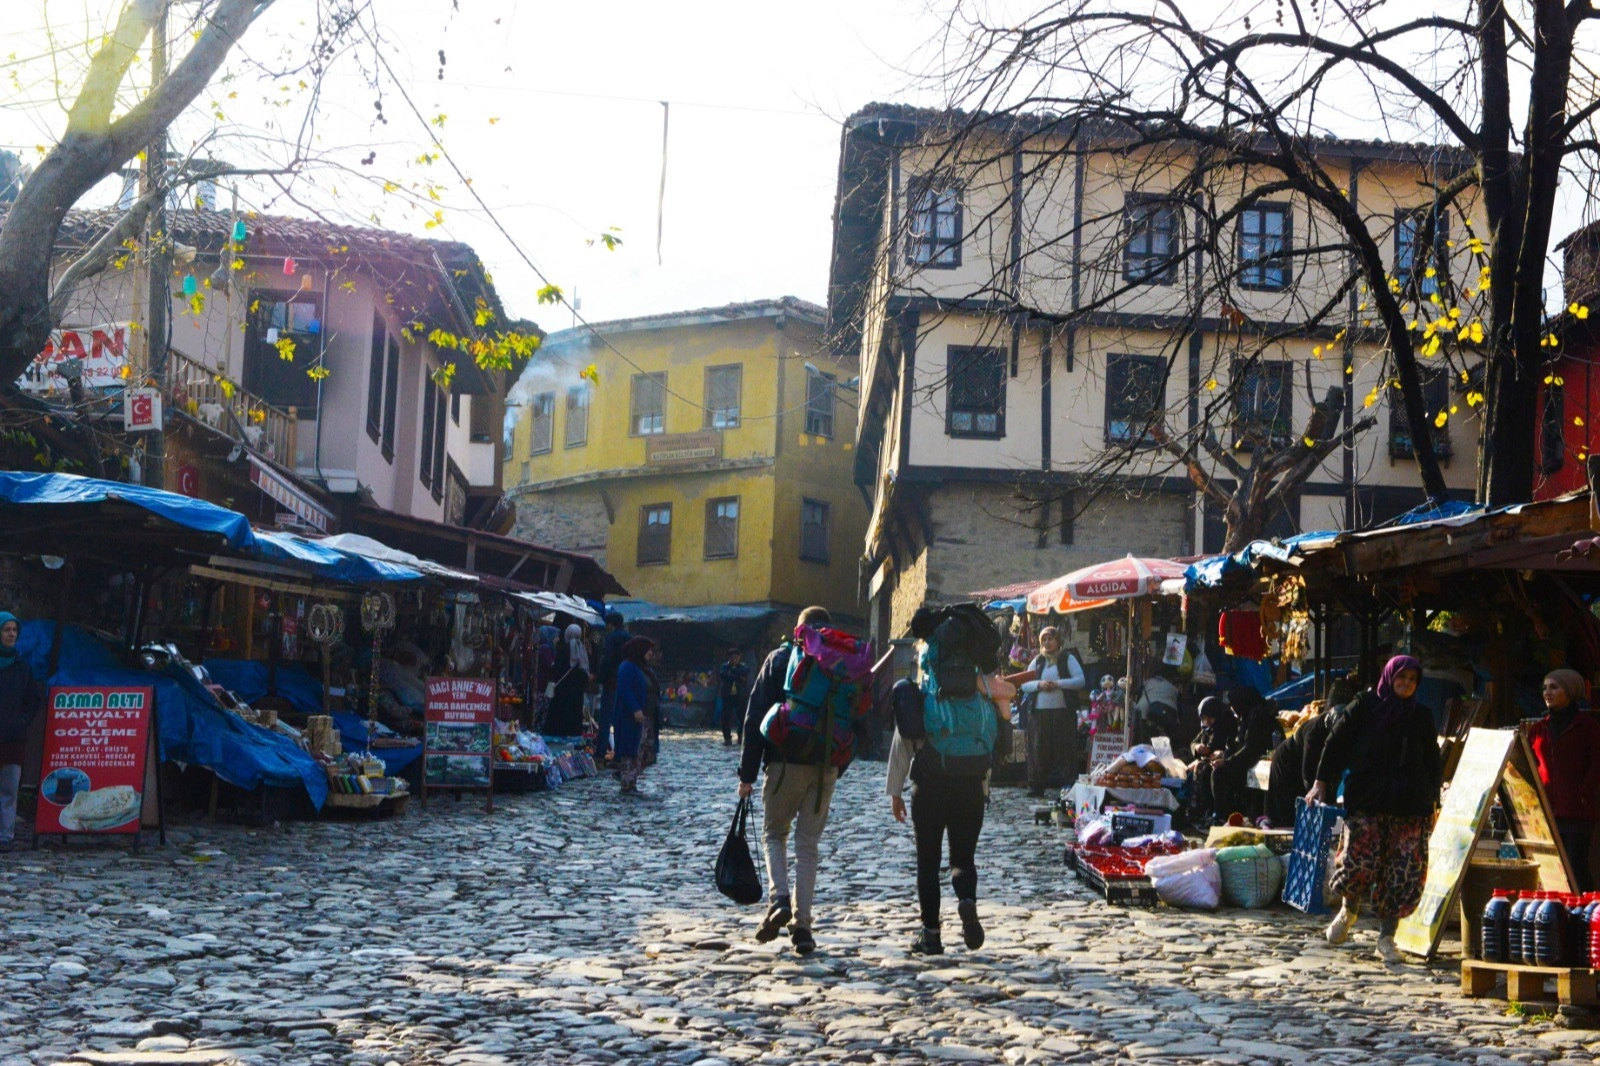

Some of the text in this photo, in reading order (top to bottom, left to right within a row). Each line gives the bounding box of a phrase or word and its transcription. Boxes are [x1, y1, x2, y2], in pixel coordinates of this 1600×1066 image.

[305, 504, 326, 529] CAFE
[1087, 582, 1128, 594] ALGIDA
[429, 680, 492, 697] HACI ANNE'NİN
[54, 692, 144, 709] ASMA ALTI
[428, 702, 491, 712] ARKA BAHÇEMİZE
[54, 711, 140, 719] KAHVALTI
[444, 712, 475, 720] BUYRUN
[54, 728, 137, 737] GÖZLEME
[81, 736, 109, 745] EVİ
